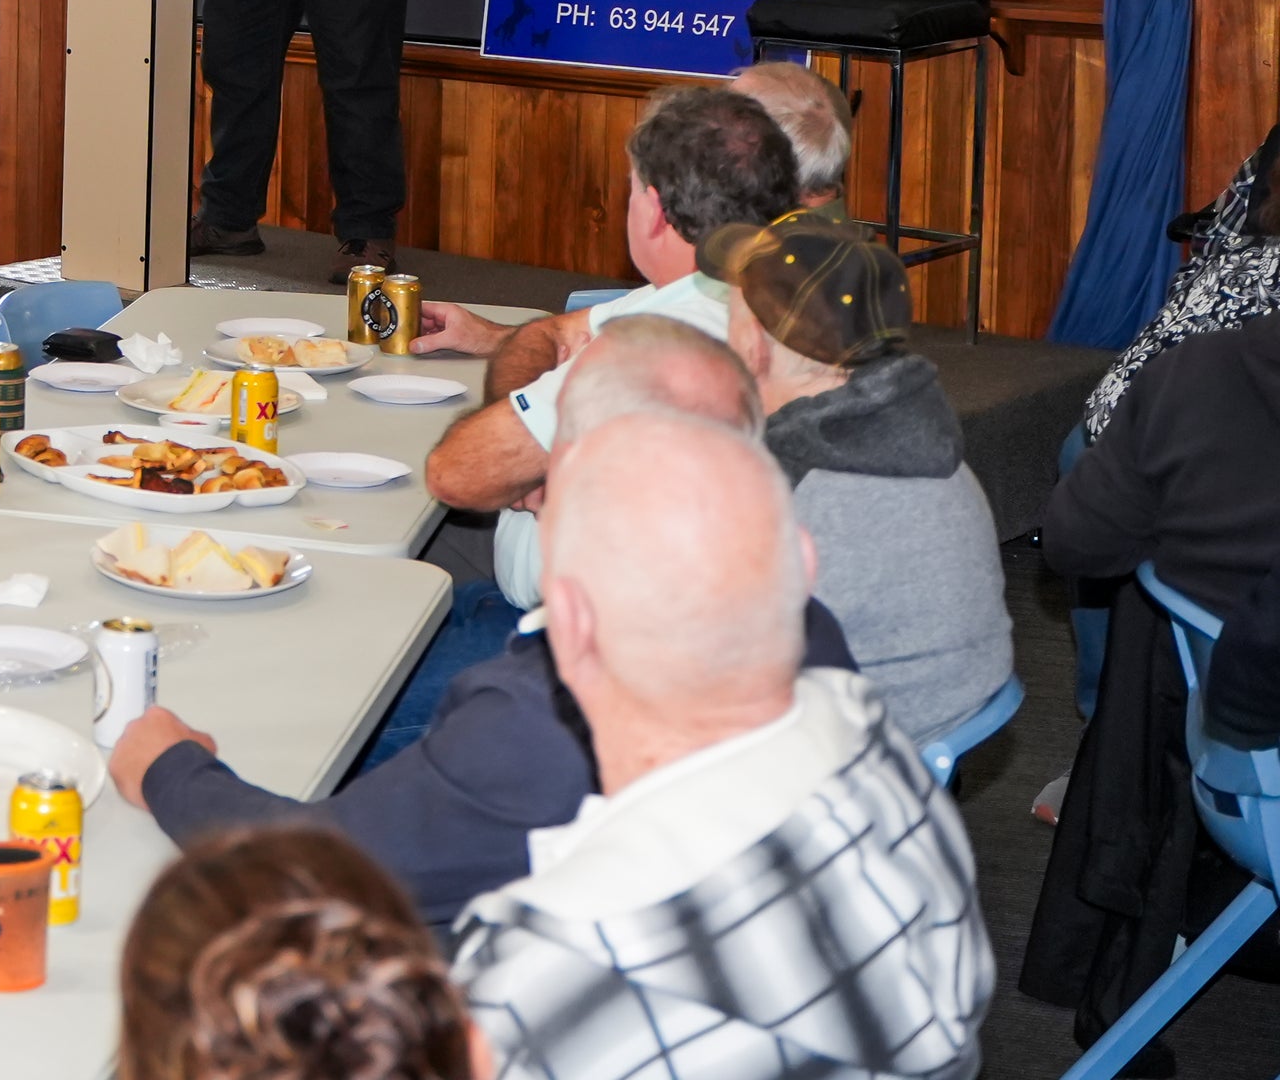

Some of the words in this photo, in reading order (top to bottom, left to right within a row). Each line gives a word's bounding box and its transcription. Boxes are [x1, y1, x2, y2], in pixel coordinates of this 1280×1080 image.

[557, 3, 594, 26] PH:
[610, 7, 637, 30] 63
[644, 10, 684, 34] 944
[693, 14, 735, 37] 547
